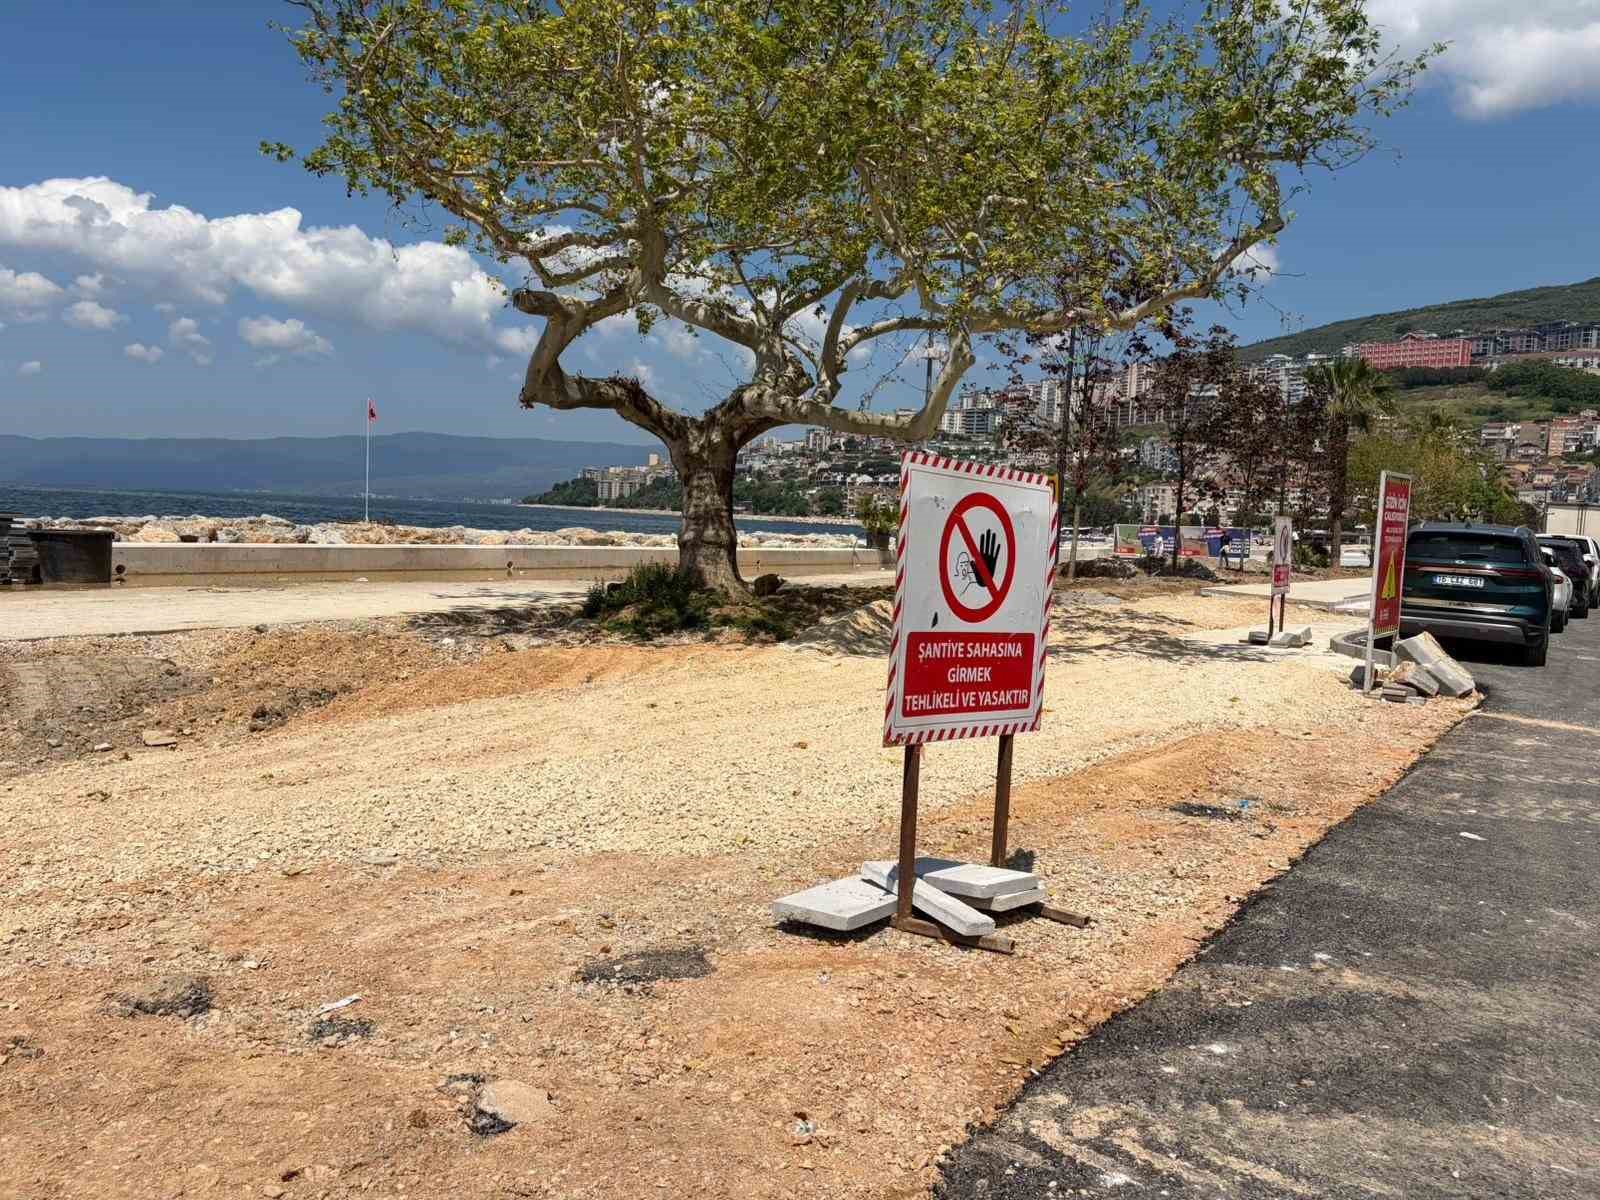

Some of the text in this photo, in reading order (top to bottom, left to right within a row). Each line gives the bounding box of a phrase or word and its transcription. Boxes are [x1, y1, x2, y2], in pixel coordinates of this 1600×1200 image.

[918, 640, 1023, 663] ŞANTİYE SAHASINA
[947, 664, 992, 683] GİRMEK
[905, 689, 1029, 711] TEHLİKELİ VE YASAKTIR
